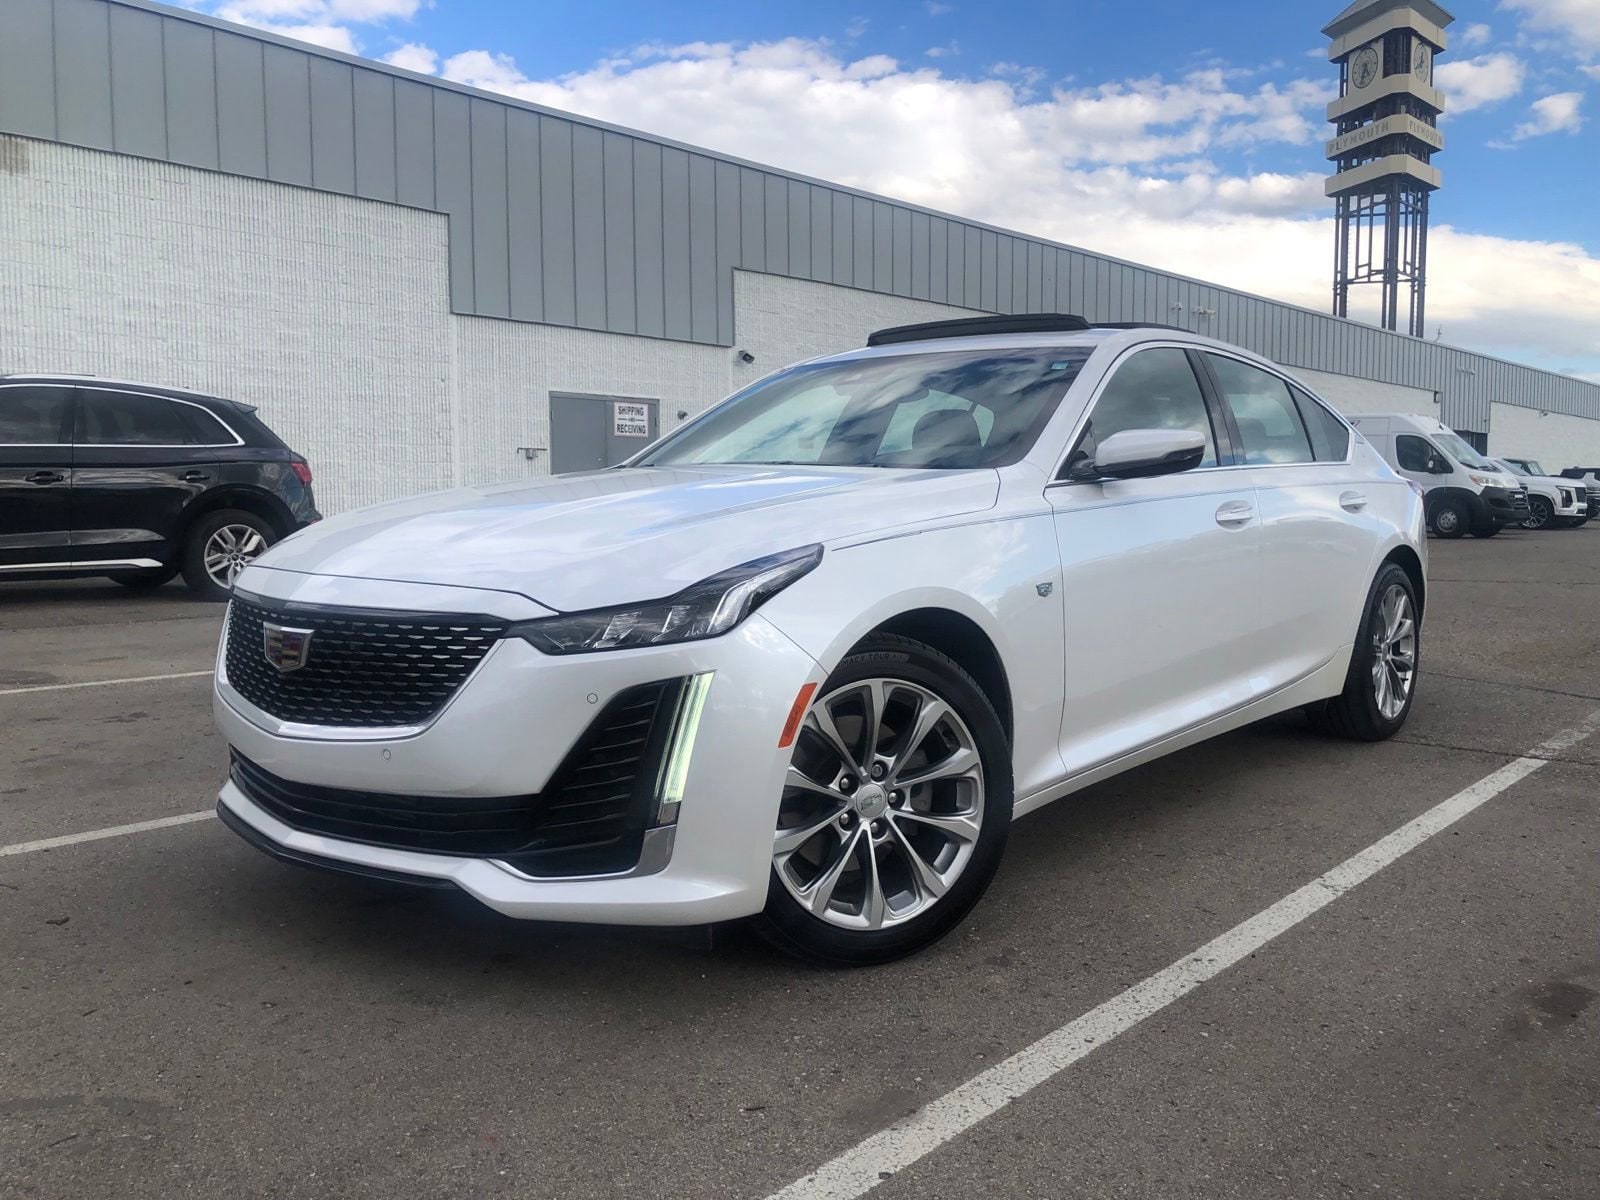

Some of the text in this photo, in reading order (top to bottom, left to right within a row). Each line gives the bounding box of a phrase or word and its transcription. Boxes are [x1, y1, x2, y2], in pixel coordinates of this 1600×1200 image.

[1328, 121, 1389, 153] PLYMOUTH
[618, 405, 644, 416] SHIPPING
[616, 423, 646, 434] RECEIVING
[868, 653, 890, 661] TOUR
